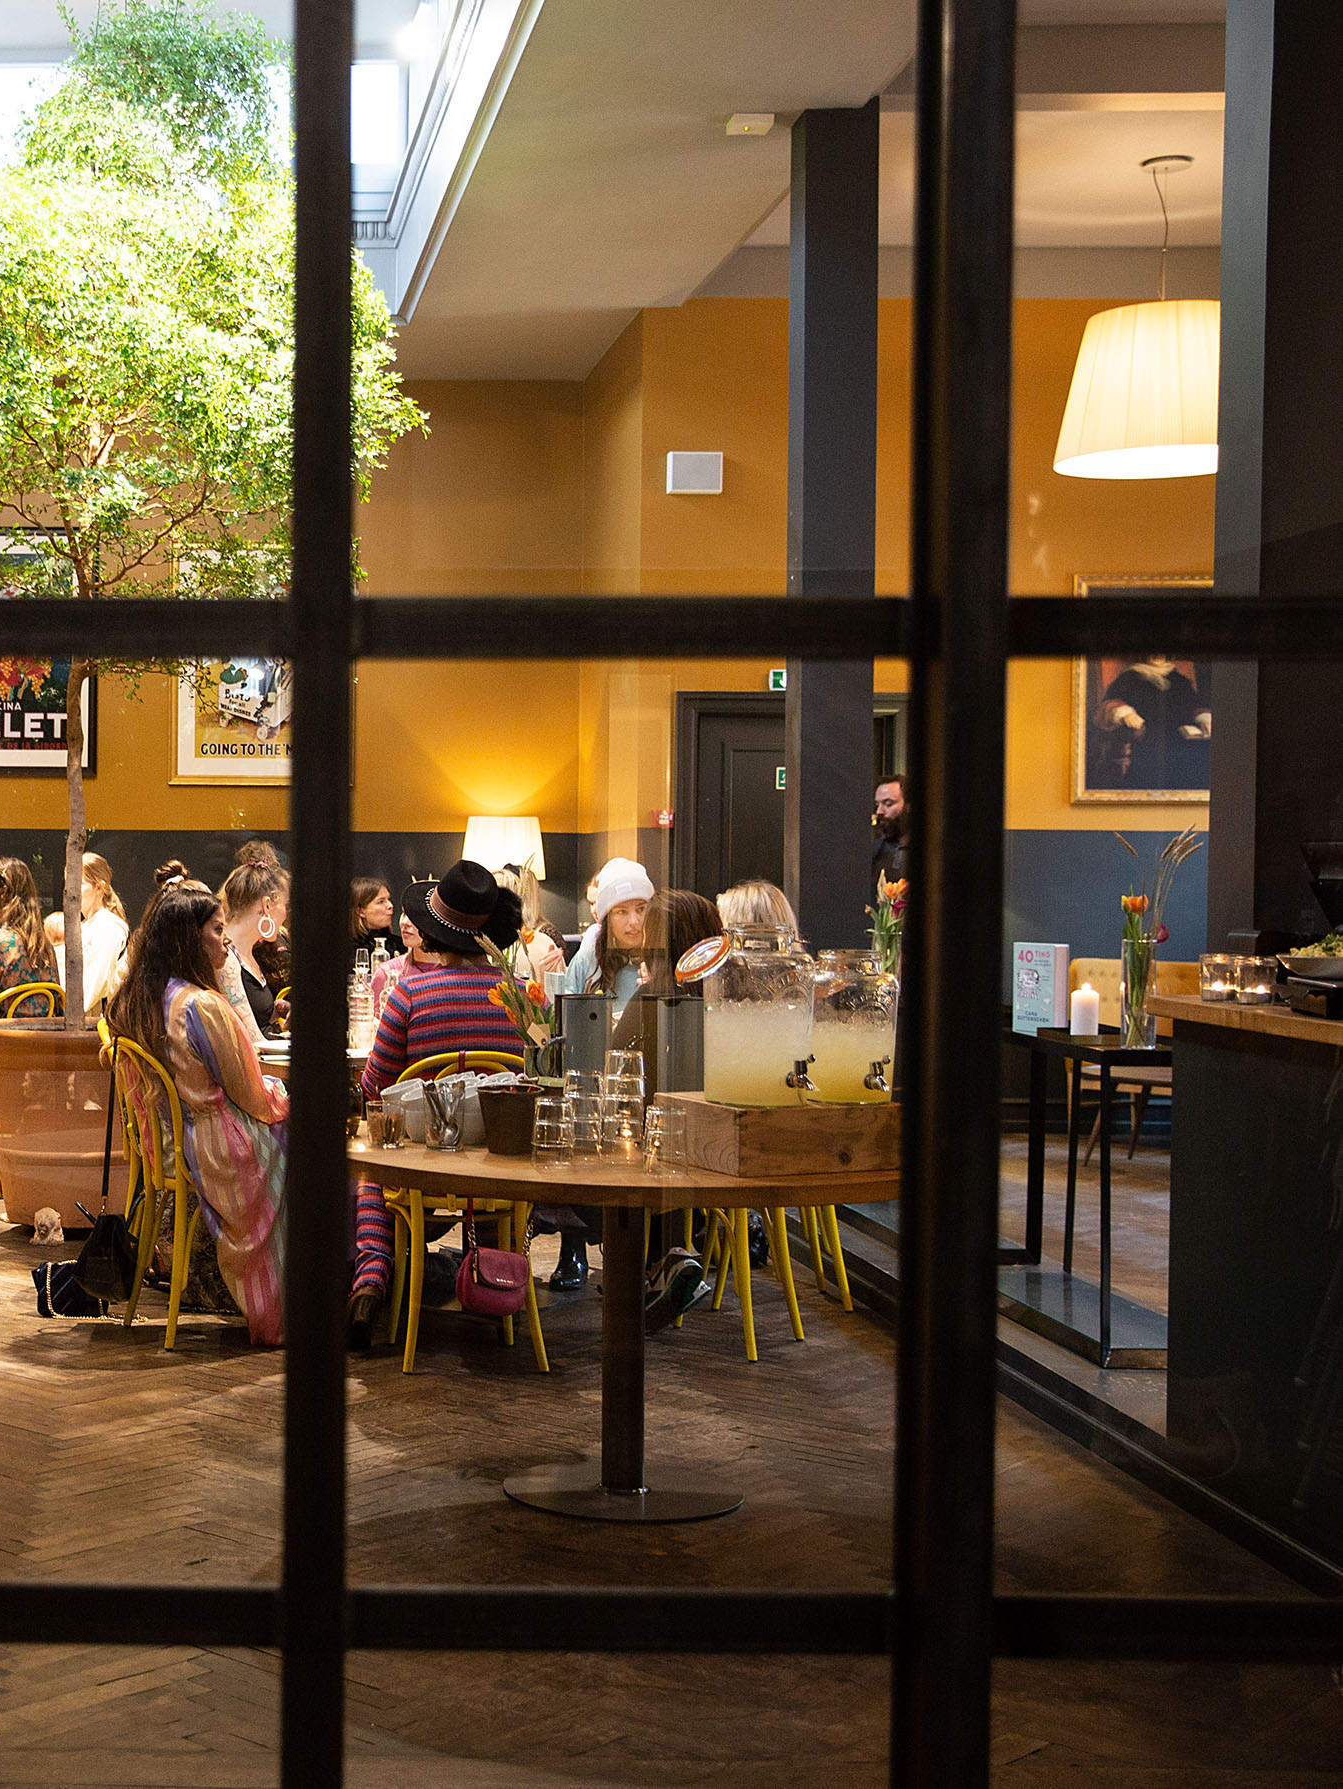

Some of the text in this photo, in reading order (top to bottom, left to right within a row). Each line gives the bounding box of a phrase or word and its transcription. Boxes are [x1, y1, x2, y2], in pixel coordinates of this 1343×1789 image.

[7, 742, 19, 750] DE
[22, 742, 31, 751] LA
[34, 742, 67, 751] GIROND
[200, 743, 238, 756] GOING
[240, 743, 256, 756] TO
[258, 743, 281, 756] THE
[1018, 950, 1034, 963] 40
